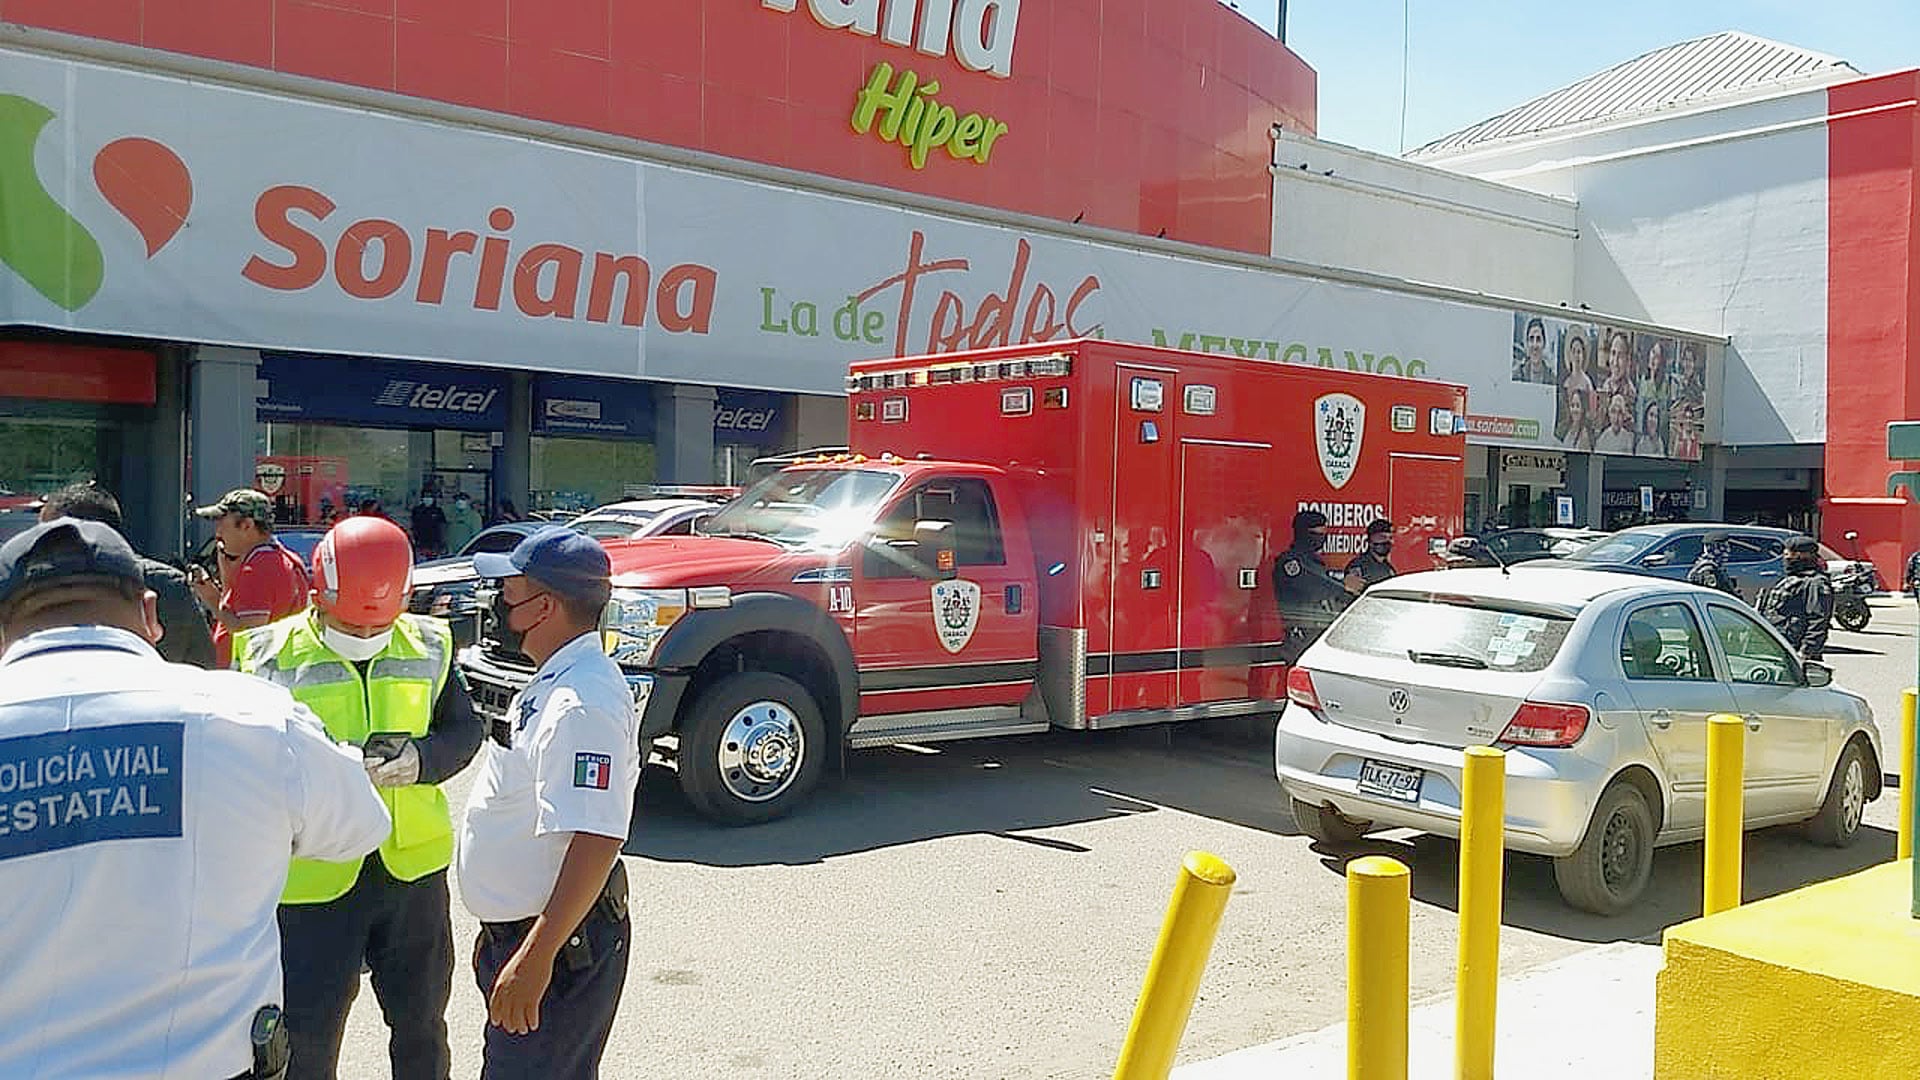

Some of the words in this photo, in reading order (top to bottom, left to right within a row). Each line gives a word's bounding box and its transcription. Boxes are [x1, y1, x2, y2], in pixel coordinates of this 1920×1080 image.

[852, 62, 1008, 169] Híper
[241, 184, 718, 335] Soriana
[760, 287, 818, 337] La
[833, 296, 884, 344] de
[408, 384, 498, 413] telcel
[829, 586, 852, 612] A-10
[103, 745, 169, 778] VIAL
